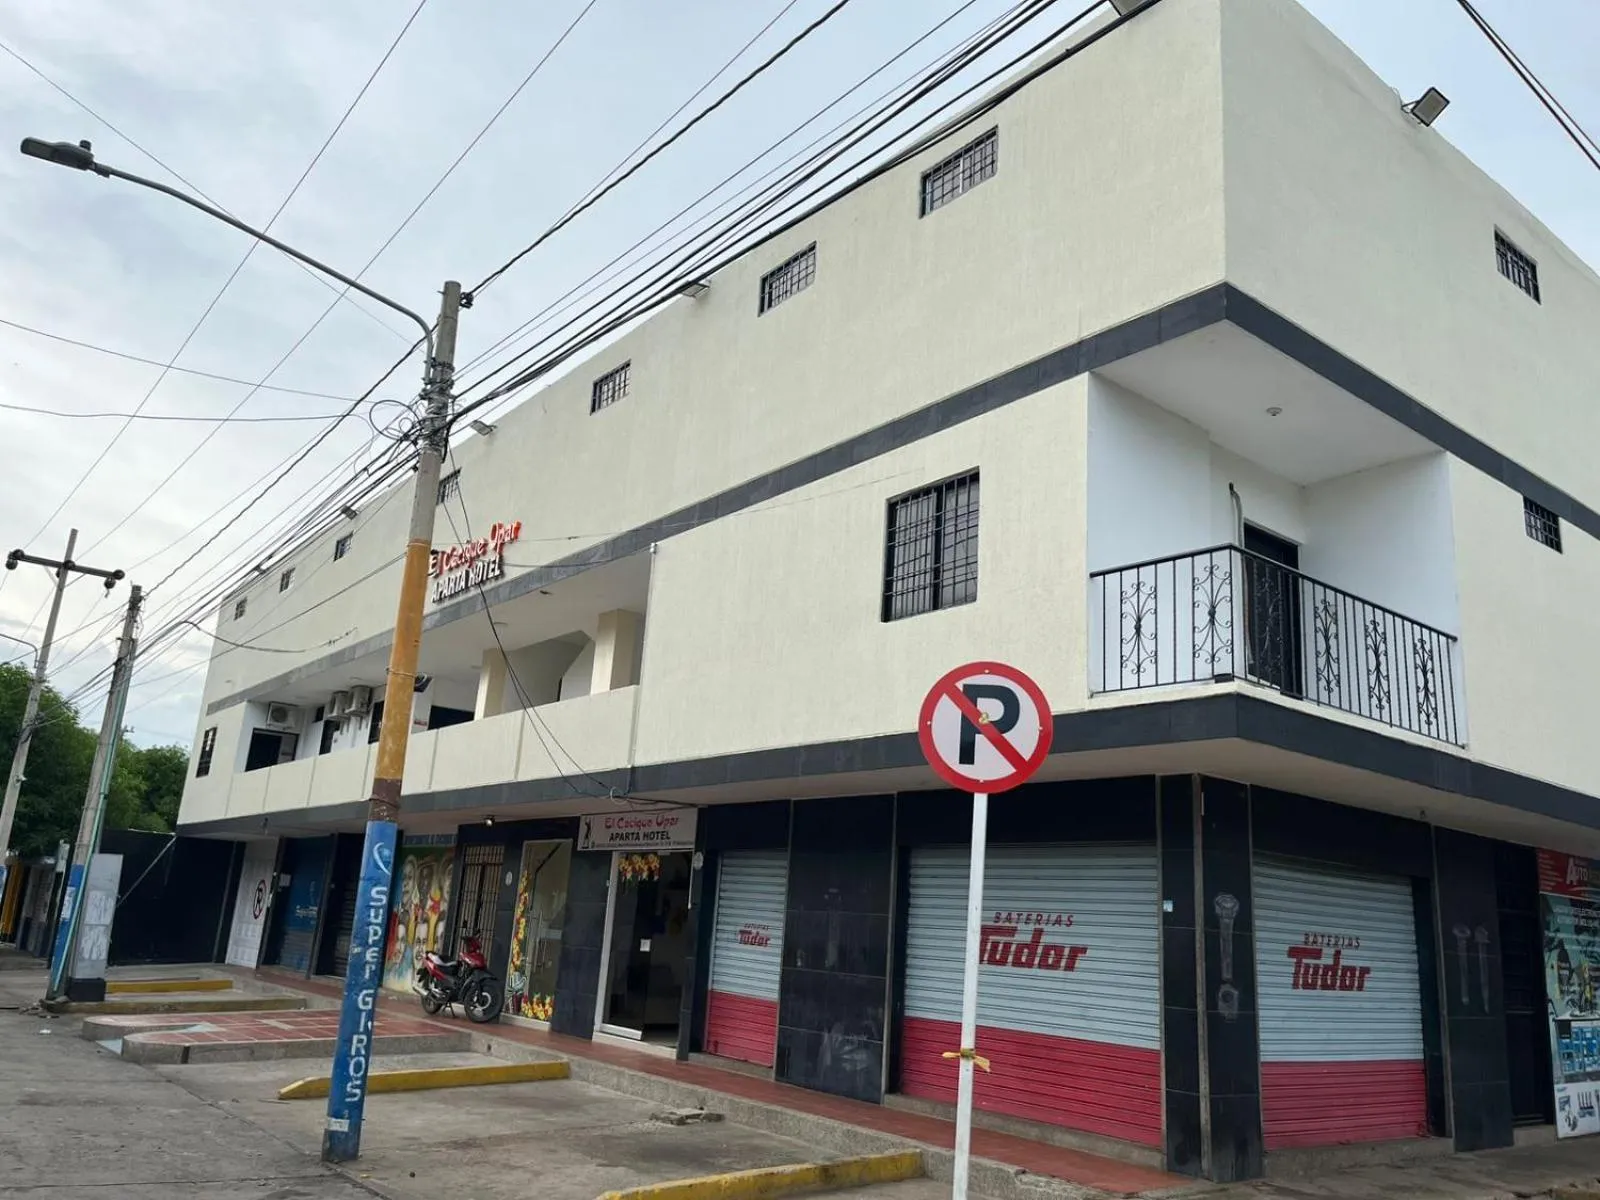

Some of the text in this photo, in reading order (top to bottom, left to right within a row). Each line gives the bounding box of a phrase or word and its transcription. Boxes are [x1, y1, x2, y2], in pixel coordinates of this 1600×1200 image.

[428, 549, 445, 578] El
[489, 521, 521, 555] Upar
[431, 555, 504, 603] APARTA HOTEL
[959, 683, 1020, 765] P
[604, 813, 679, 832] El Cacique Upar
[609, 830, 671, 842] APARTA HOTEL
[738, 929, 771, 947] Tudor
[993, 911, 1075, 928] BATERIAS
[1303, 932, 1361, 949] BATERIAS
[980, 925, 1088, 972] Tudor
[1286, 946, 1371, 991] Tudor
[345, 989, 375, 1102] GIROS
